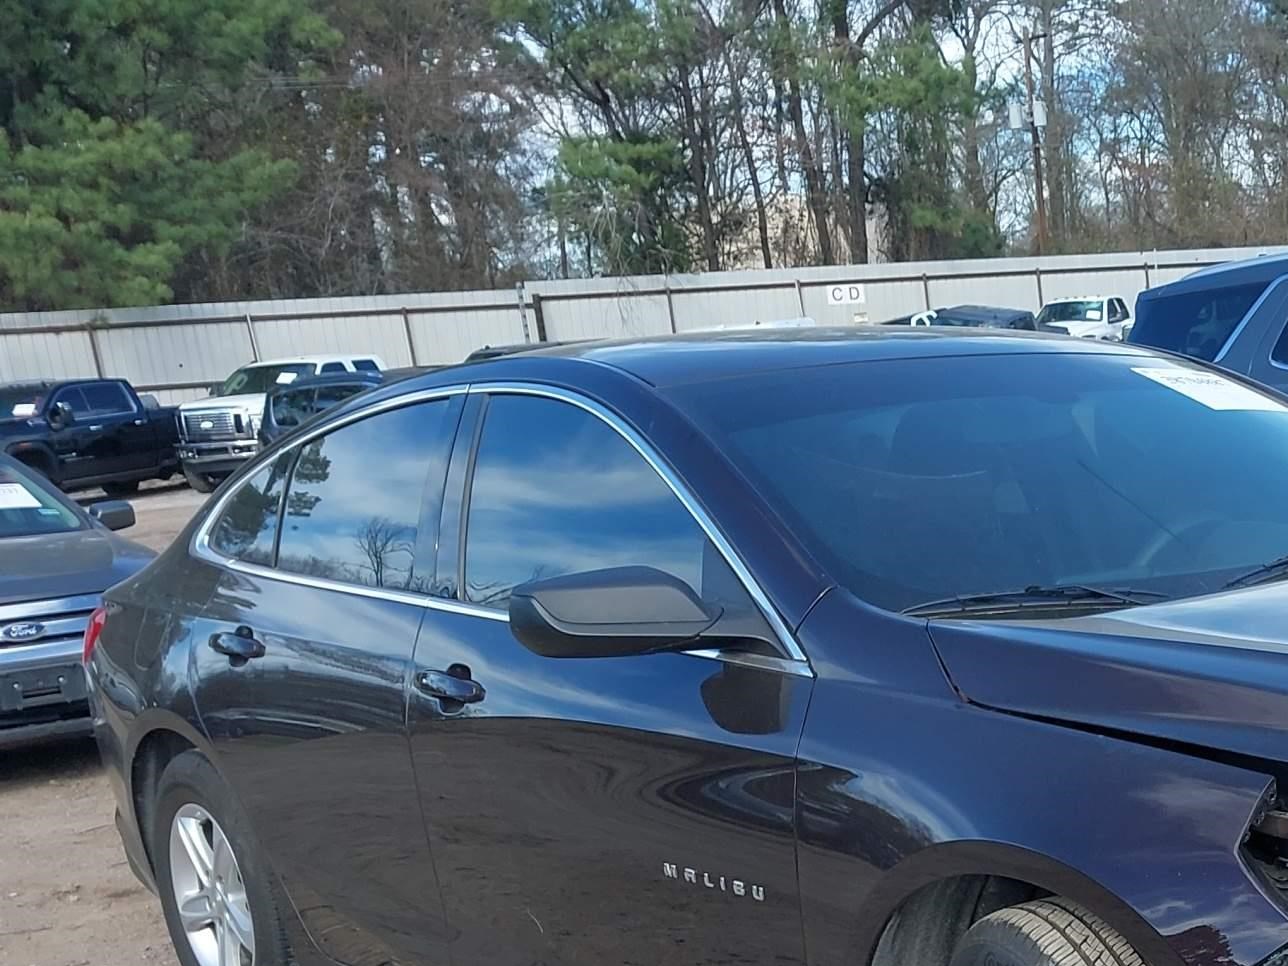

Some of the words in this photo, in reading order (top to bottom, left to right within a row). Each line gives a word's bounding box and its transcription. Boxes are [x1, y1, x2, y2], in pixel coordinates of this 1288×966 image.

[831, 286, 844, 302] C
[848, 285, 861, 301] D
[9, 623, 38, 638] Ford
[663, 861, 766, 902] MALIBU
